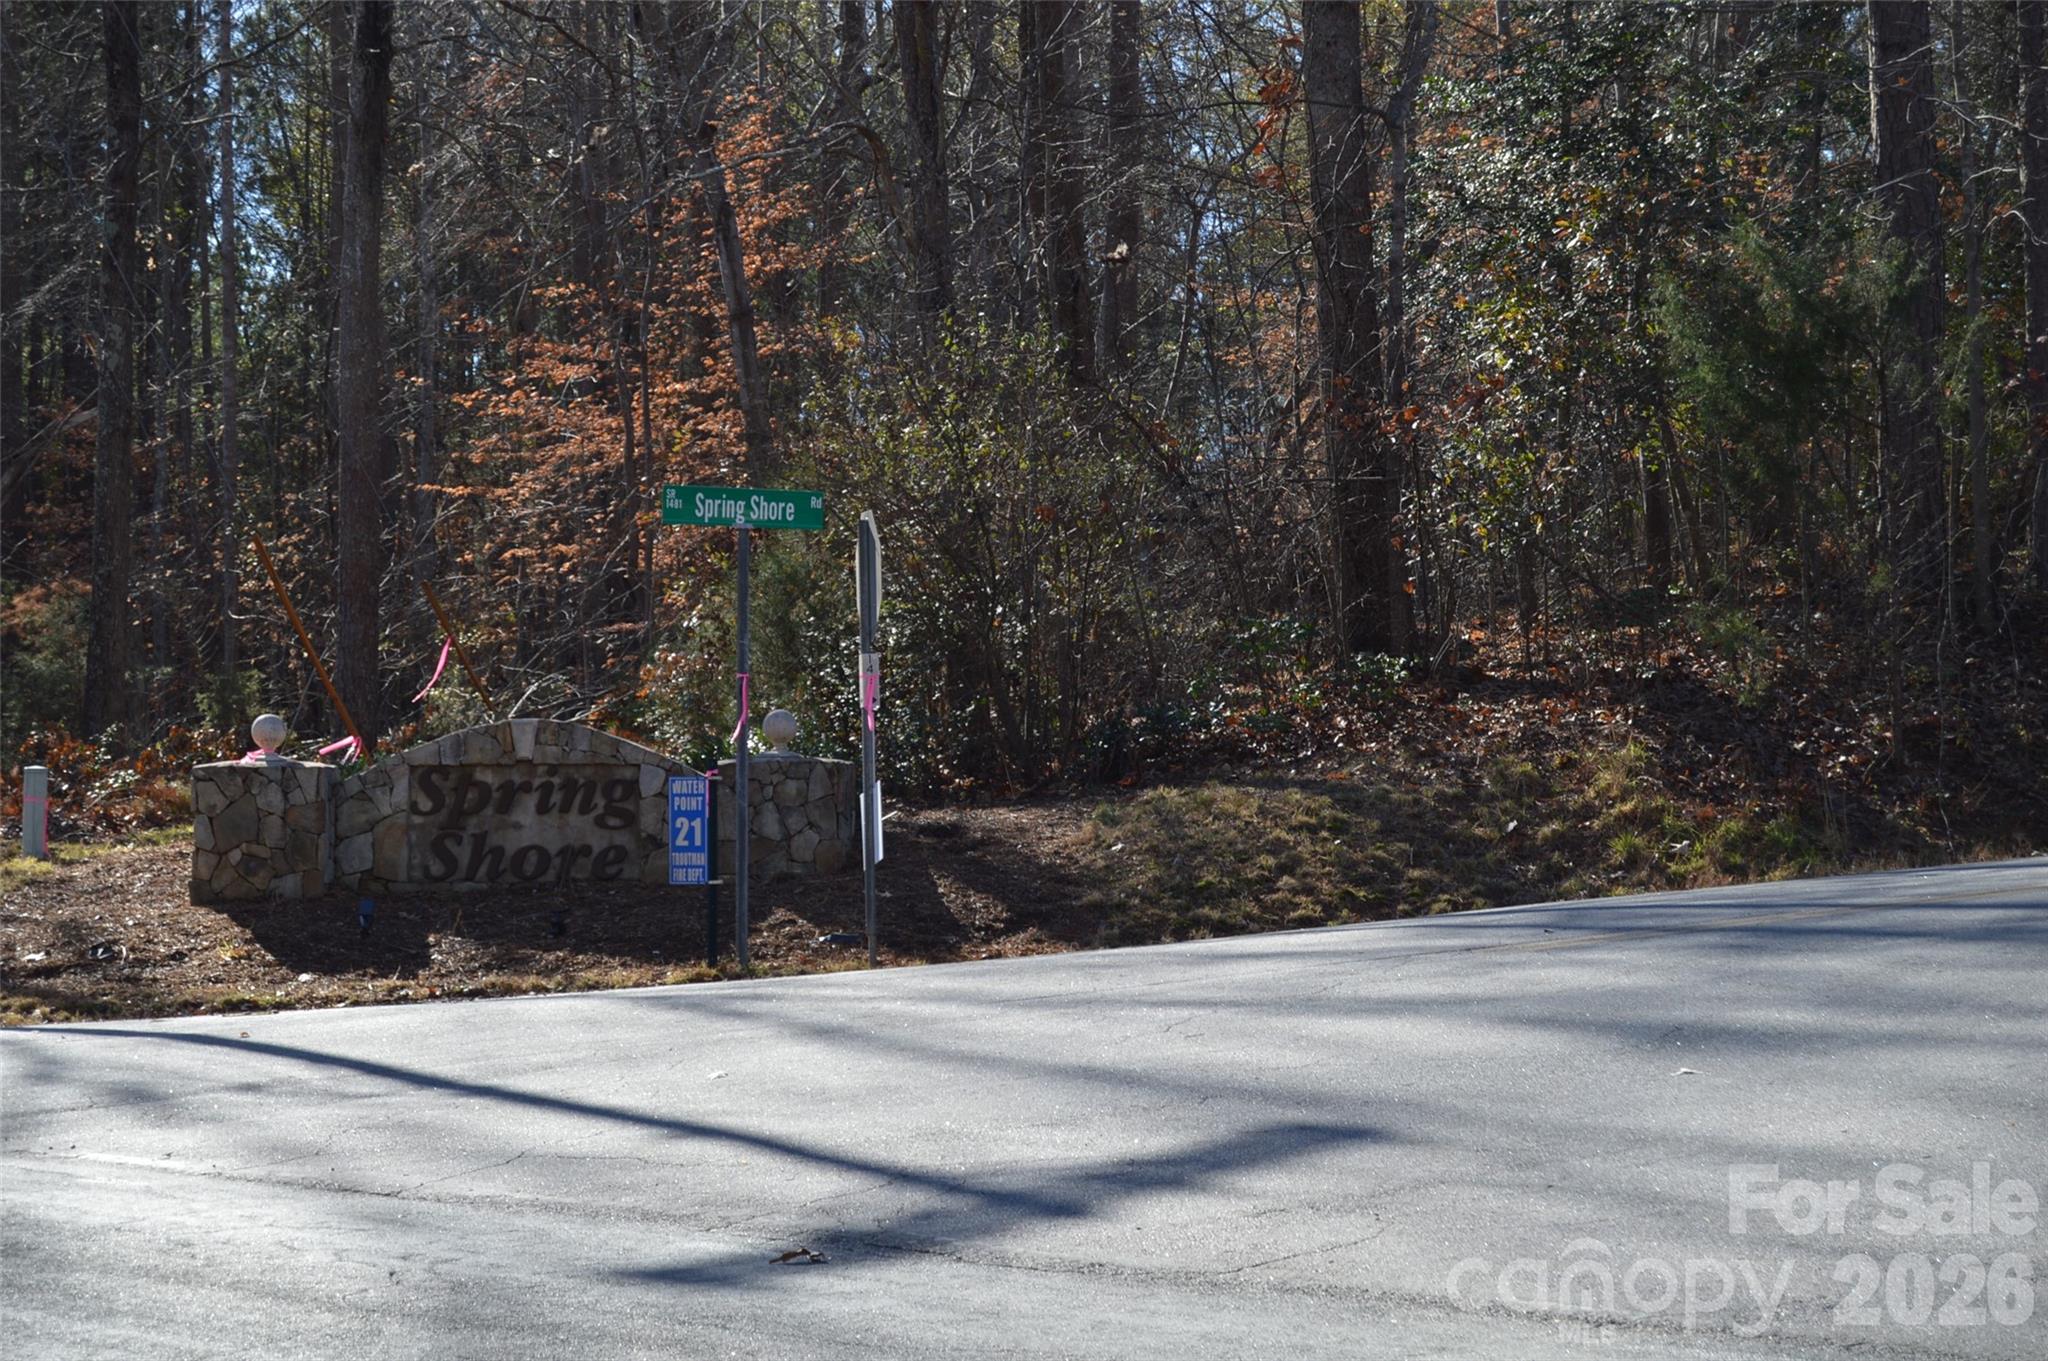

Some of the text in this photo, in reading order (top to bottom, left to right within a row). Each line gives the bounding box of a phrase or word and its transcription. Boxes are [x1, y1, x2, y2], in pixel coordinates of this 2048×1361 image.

[695, 492, 822, 524] Spring Shore Rd
[410, 766, 638, 830] Spring
[672, 780, 705, 794] WATER
[674, 797, 703, 811] POINT
[675, 817, 702, 846] 21
[423, 831, 629, 882] Shore
[673, 867, 686, 881] FIRE
